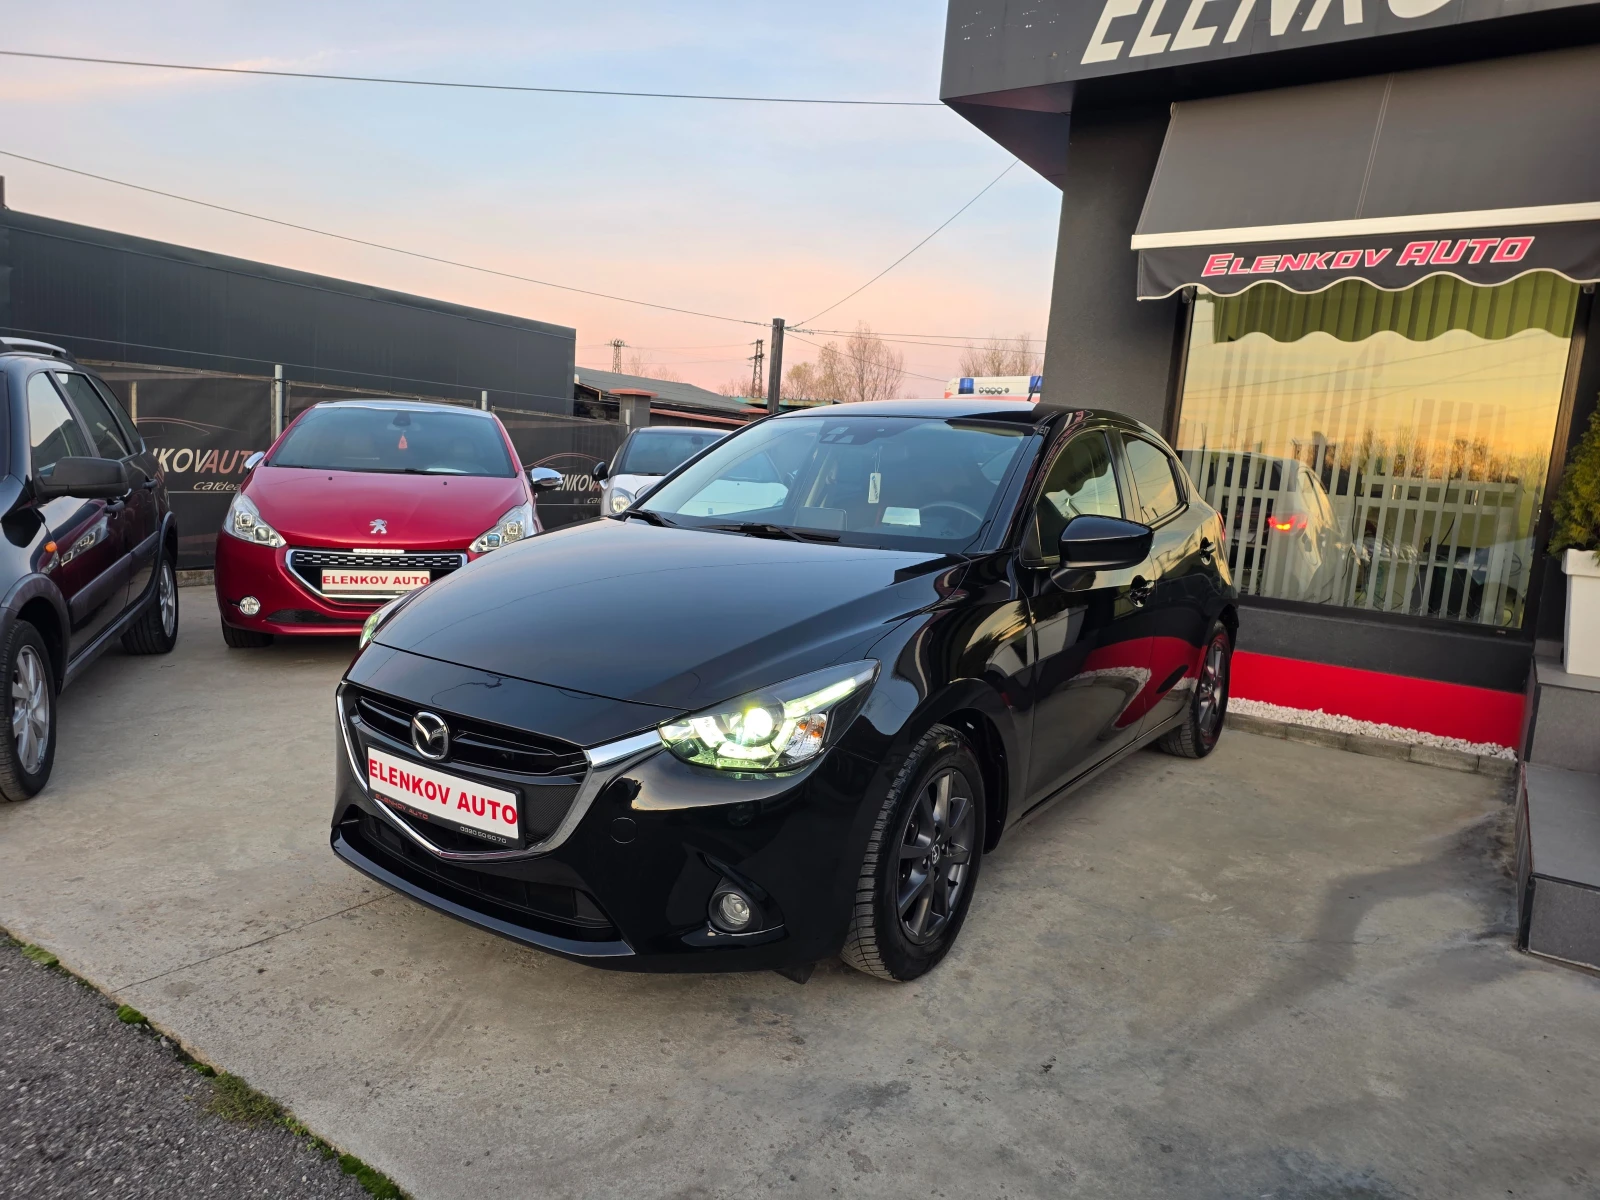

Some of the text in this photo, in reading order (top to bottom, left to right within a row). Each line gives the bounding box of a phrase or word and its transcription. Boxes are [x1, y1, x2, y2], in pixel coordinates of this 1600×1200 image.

[1201, 236, 1535, 277] ELENKOV AUTO
[152, 447, 254, 474] KOVAUT
[322, 575, 430, 586] ELENKOV AUTO
[369, 758, 518, 825] ELENKOV AUTO
